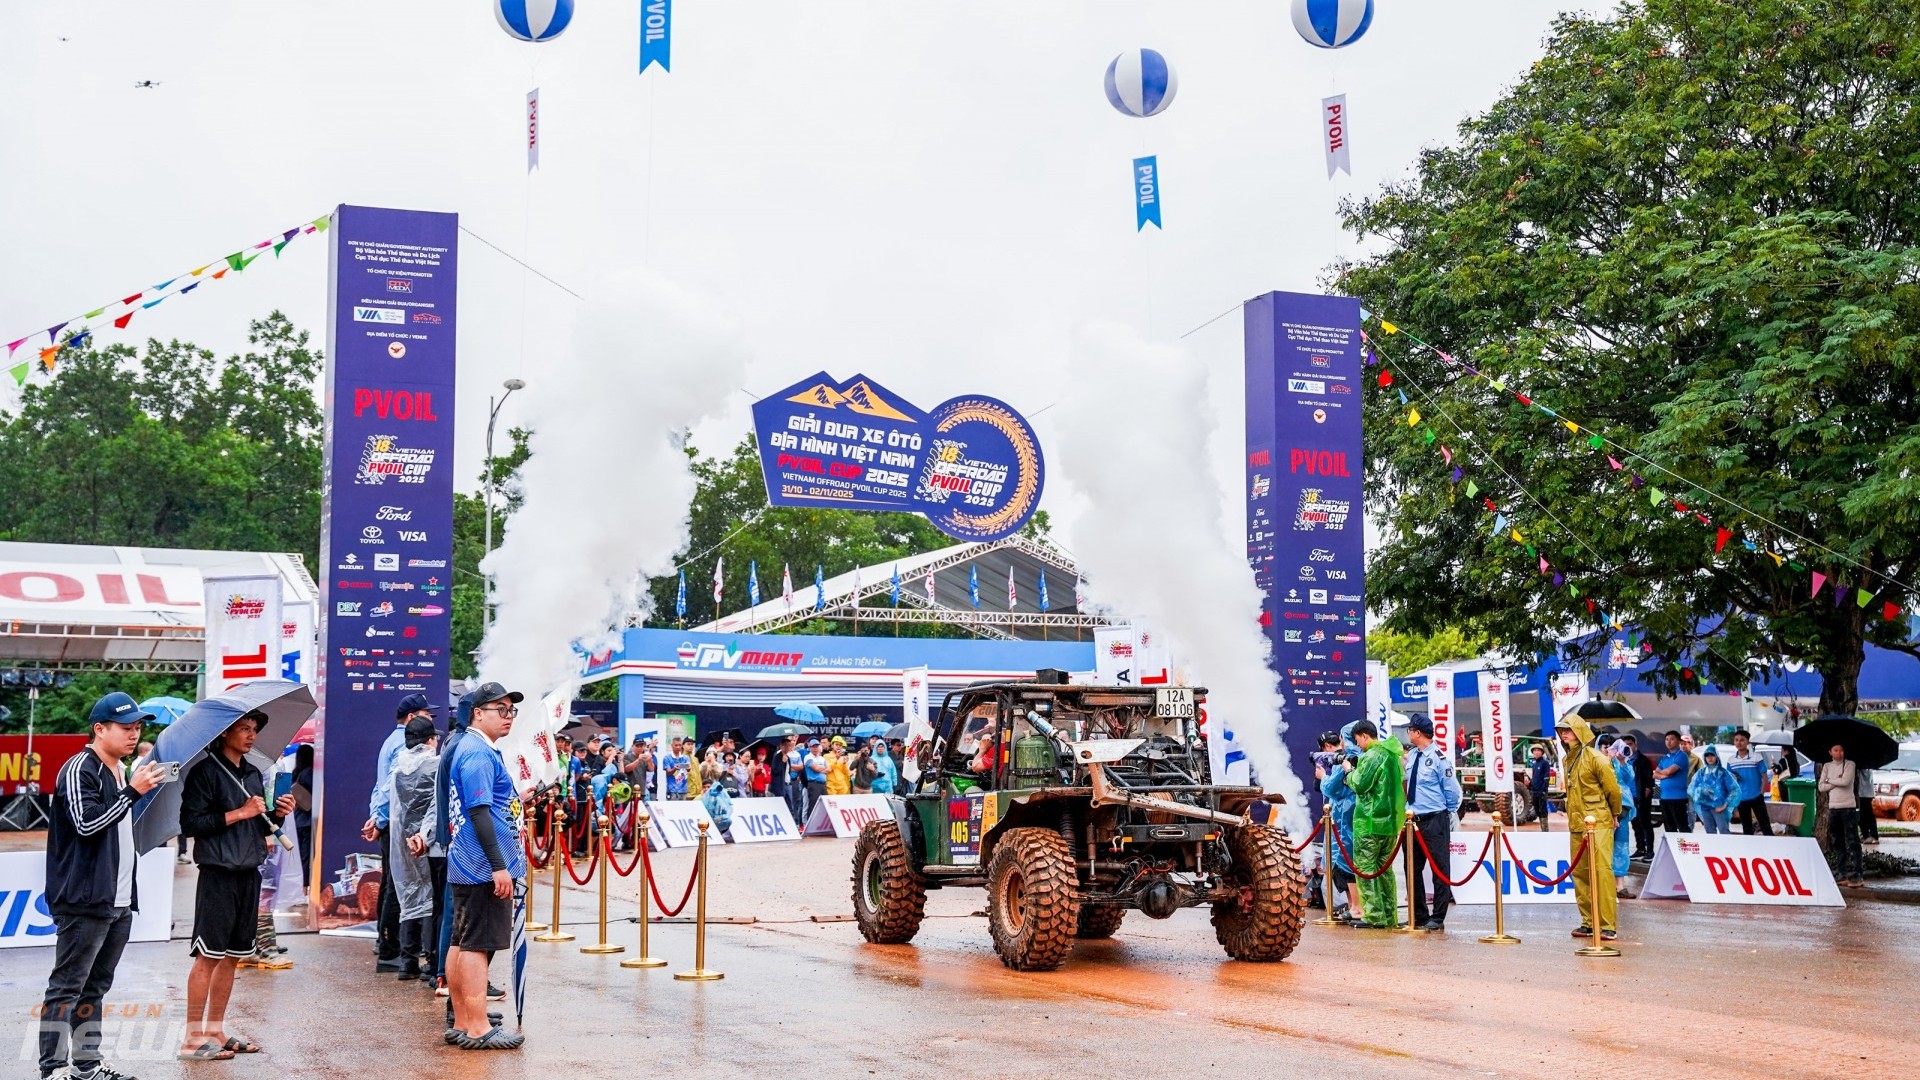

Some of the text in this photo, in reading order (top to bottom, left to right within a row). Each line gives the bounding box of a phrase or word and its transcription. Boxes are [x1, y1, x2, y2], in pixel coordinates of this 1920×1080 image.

[646, 0, 666, 44] VOIL
[1327, 104, 1343, 153] PVOIL
[1138, 165, 1154, 208] PVOIL
[354, 388, 437, 422] PVOIL
[788, 413, 922, 450] GIẢI ĐUA XE ÔTÔ
[374, 439, 391, 453] 18
[770, 431, 915, 468] ĐỊA HÌNH VIỆT NAM
[370, 453, 435, 464] OFFROAD
[940, 446, 959, 463] 18
[1249, 450, 1271, 469] PVOIL
[1290, 448, 1350, 477] PVOIL
[368, 462, 431, 475] PVOIL CUP
[777, 453, 910, 488] PVOIL CUP 2025
[935, 462, 1008, 483] OFFROAD
[964, 459, 1009, 472] VIETNAM
[782, 472, 907, 498] VIETNAM OFFROAD PVOIL CUP 2025
[782, 485, 803, 494] 31/10
[809, 487, 854, 498] 02/11/2025
[929, 473, 1003, 497] PVOIL CUP
[963, 495, 995, 507] 2025
[1306, 492, 1318, 503] 18
[376, 506, 412, 521] Ford
[1305, 503, 1350, 513] OFFROAD
[1302, 512, 1347, 523] PVOIL CUP
[397, 531, 427, 541] VISA
[1309, 548, 1335, 562] Ford
[1325, 570, 1347, 580] VISA
[812, 655, 886, 667] CỬA HÀNG TIỆN ÍCH
[1508, 672, 1528, 686] Ford
[1167, 690, 1185, 702] 12A
[1158, 703, 1193, 716] 081.06
[844, 715, 861, 724] ÔTÔ
[1491, 700, 1503, 752] GWM
[819, 726, 839, 736] VIỆT
[670, 818, 711, 841] VIS
[738, 814, 787, 837] VISA
[951, 821, 968, 844] 405
[1472, 859, 1575, 896] VISA
[1704, 856, 1812, 896] PVOIL
